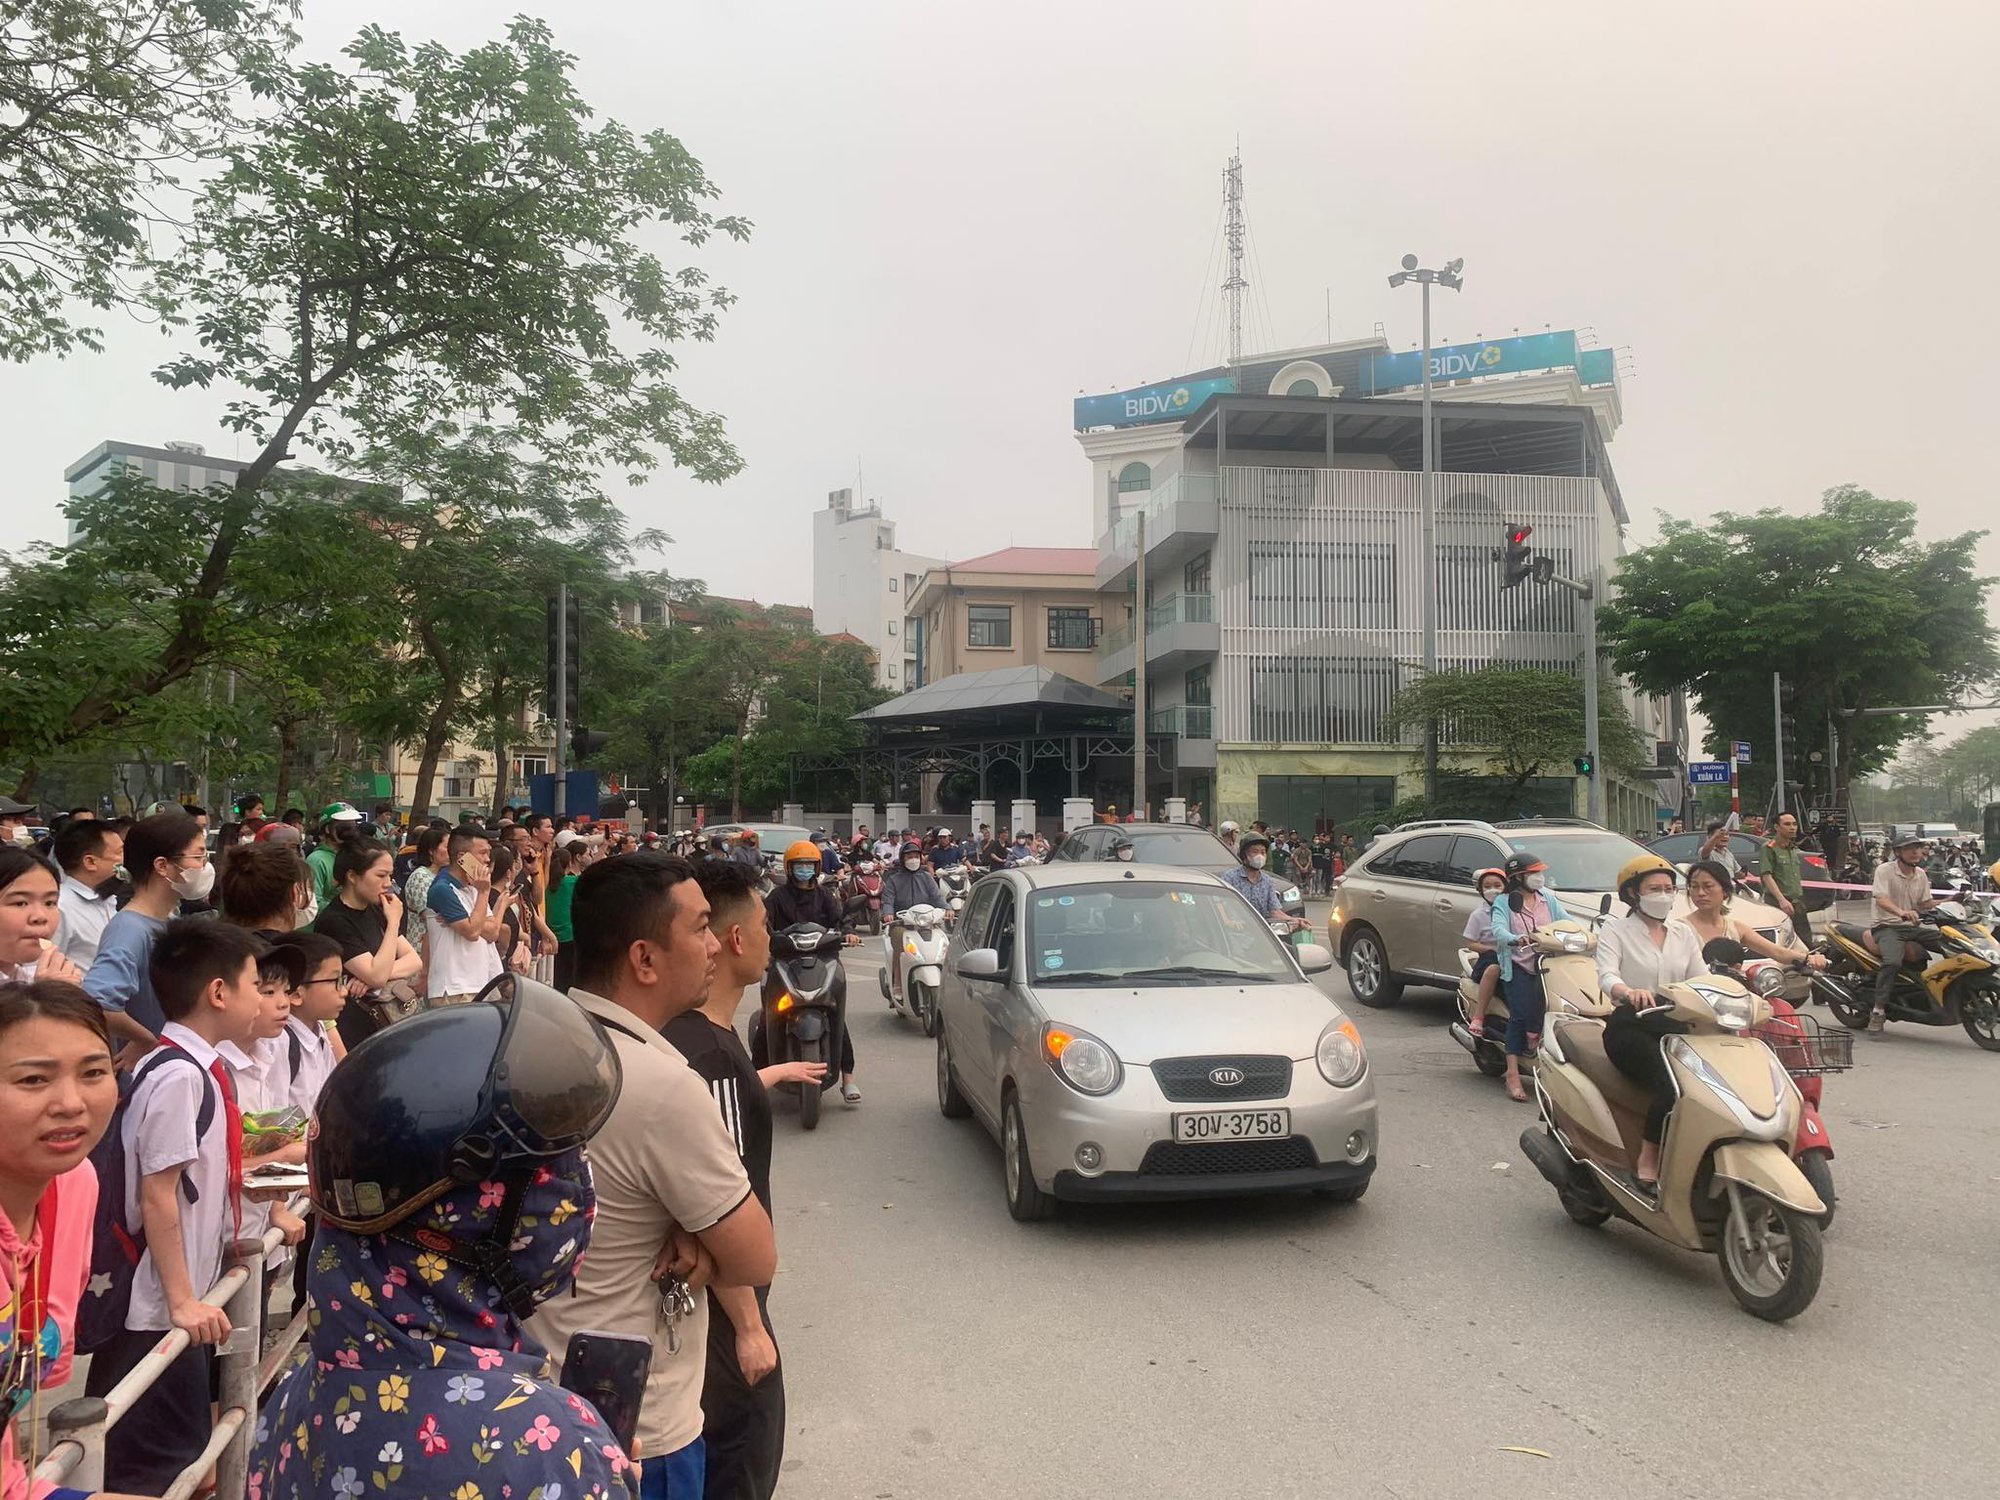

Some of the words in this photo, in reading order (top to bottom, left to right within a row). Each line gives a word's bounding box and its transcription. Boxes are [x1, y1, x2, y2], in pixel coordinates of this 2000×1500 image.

[1430, 352, 1481, 376] BIDV
[1125, 394, 1172, 417] BIDV
[1697, 771, 1713, 781] XUÂN
[1715, 772, 1723, 781] LA
[1214, 1071, 1239, 1082] KIA
[1184, 1113, 1281, 1138] 30V-3758
